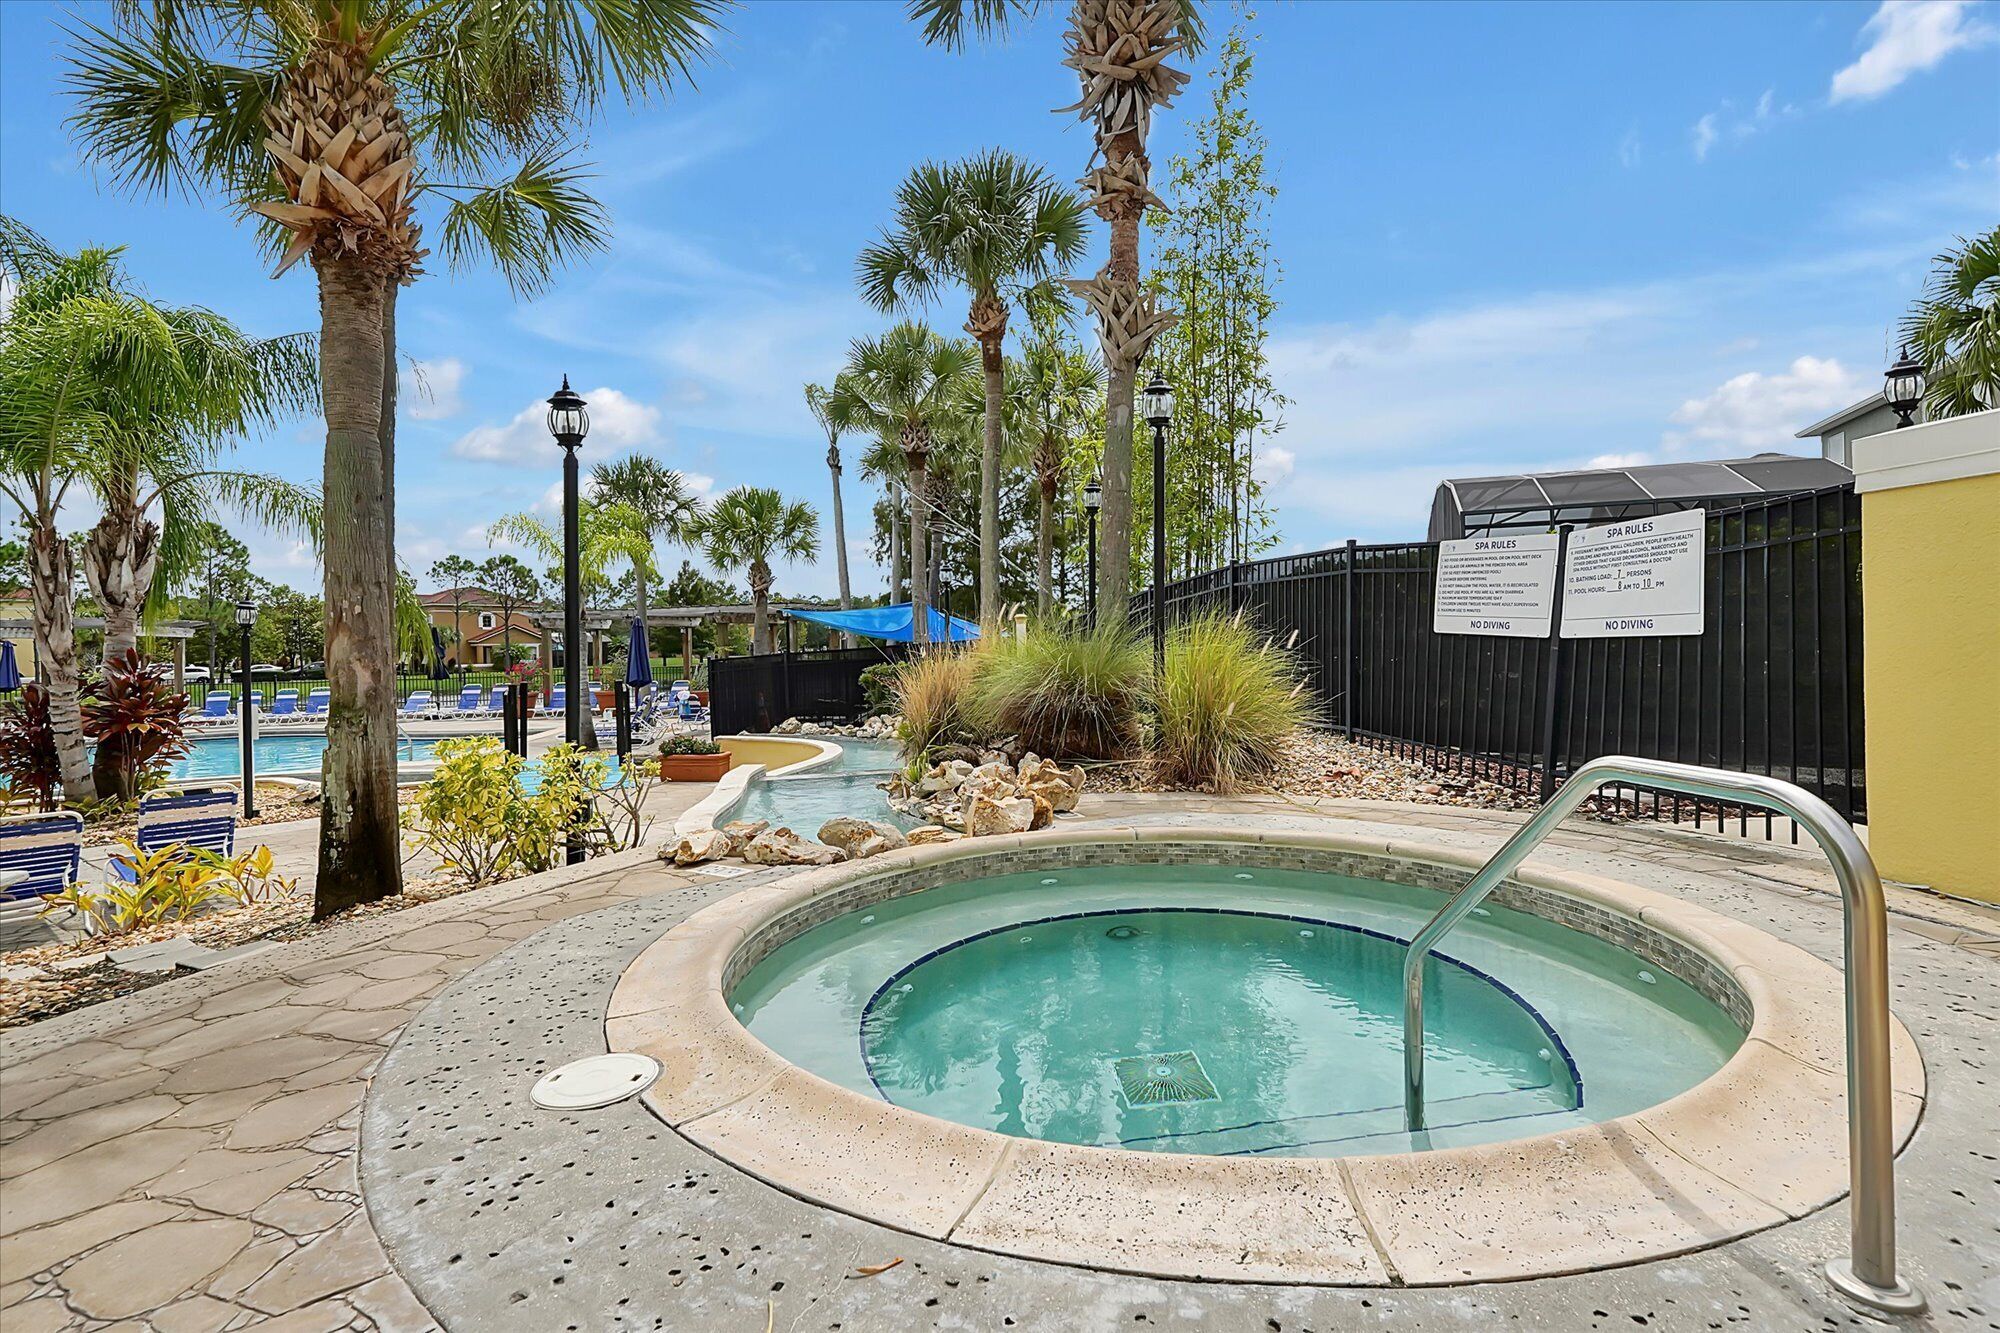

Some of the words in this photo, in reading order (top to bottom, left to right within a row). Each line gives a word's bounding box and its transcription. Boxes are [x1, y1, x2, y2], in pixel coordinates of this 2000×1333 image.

[1607, 528, 1622, 538] SPA
[1625, 522, 1654, 534] RULES
[1475, 541, 1489, 550] SPA
[1491, 540, 1517, 549] RULES
[1626, 569, 1652, 577] PERSONS
[1643, 578, 1651, 588] 10
[1470, 620, 1481, 629] NO
[1483, 621, 1510, 630] DIVING
[1606, 621, 1618, 630] NO
[1621, 619, 1653, 630] DIVING
